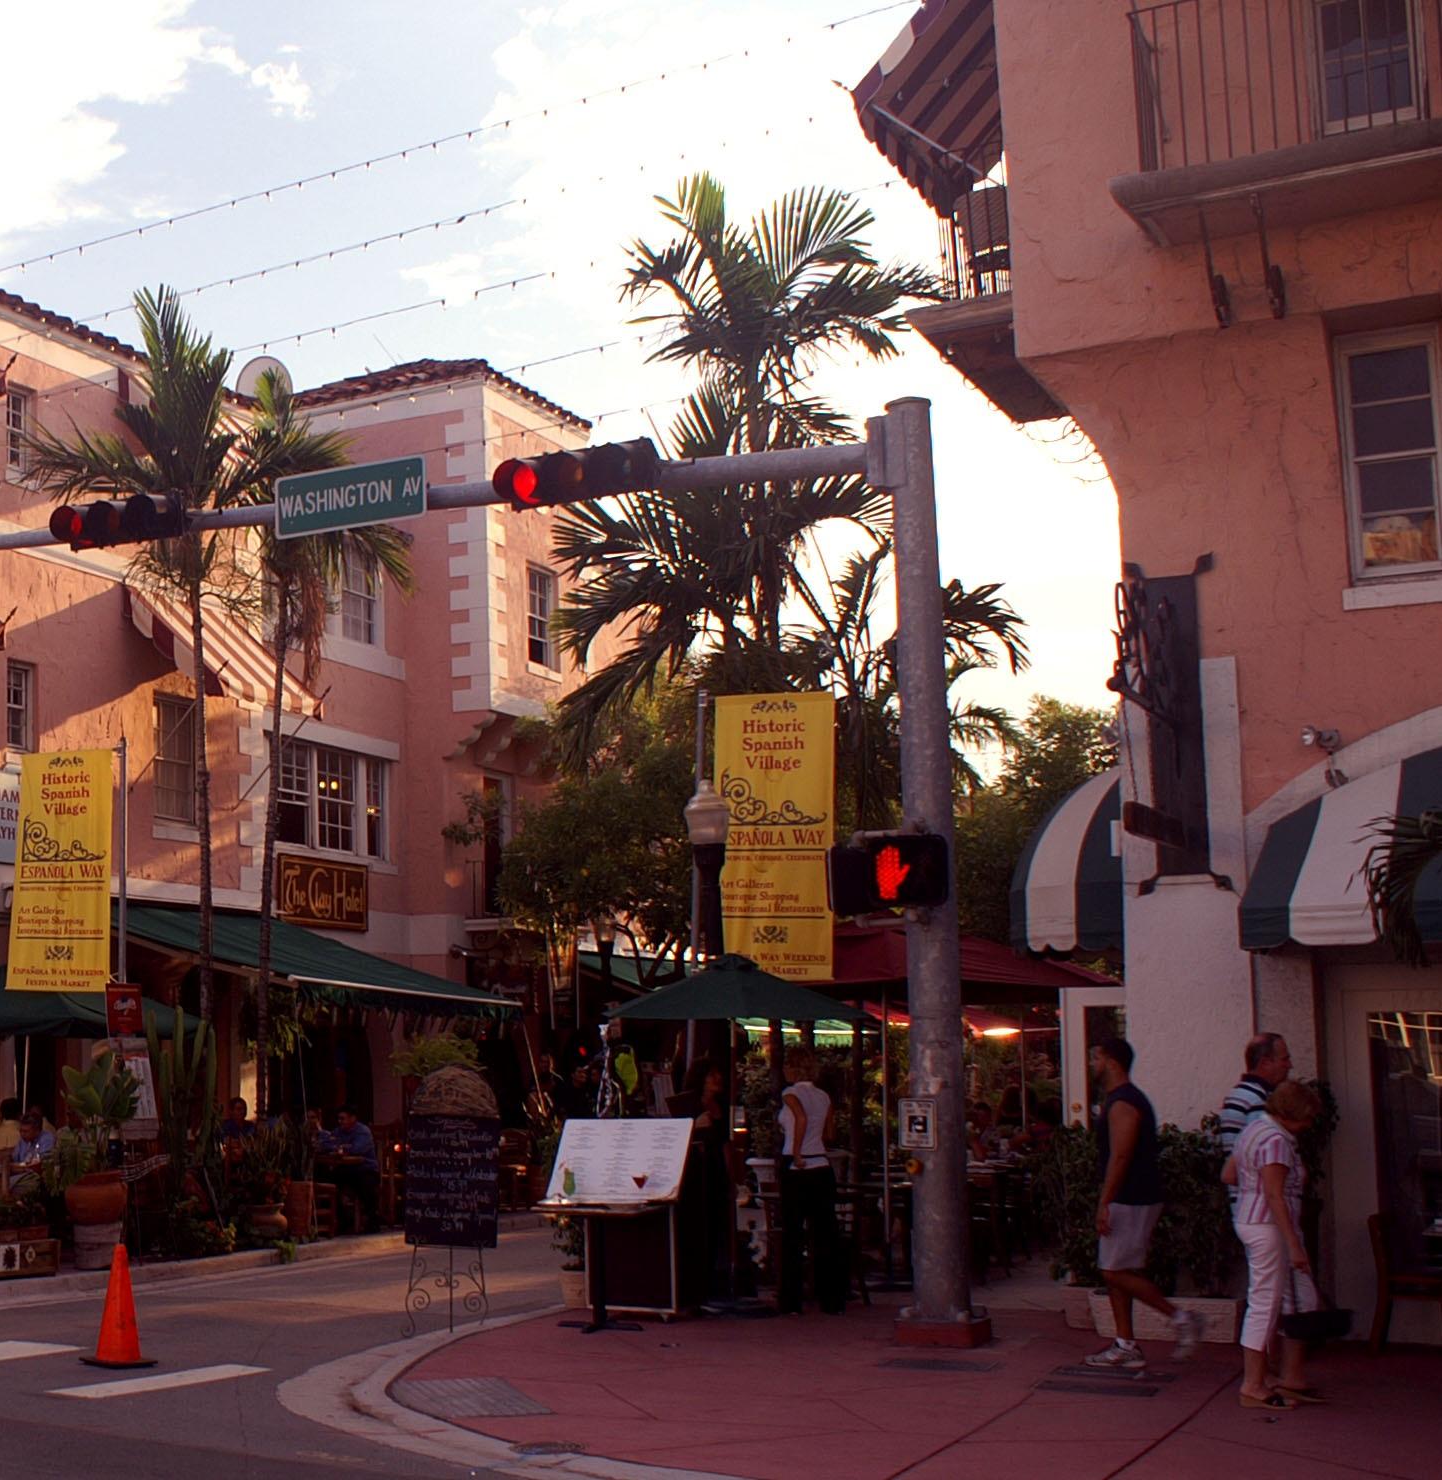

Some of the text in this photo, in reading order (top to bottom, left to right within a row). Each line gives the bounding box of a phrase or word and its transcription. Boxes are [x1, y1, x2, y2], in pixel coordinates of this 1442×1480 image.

[280, 476, 421, 519] WASHINGTON AV
[743, 719, 805, 733] Historic
[742, 737, 804, 752] Spanish
[746, 756, 801, 771] Village
[42, 771, 90, 785] Historic
[41, 786, 90, 801] Spanish
[44, 803, 87, 816] Village
[729, 828, 824, 846] SPAÑOLA WAY
[21, 863, 104, 878] ESPAÑOLA WAY
[736, 878, 774, 889] Galleries
[285, 864, 363, 920] The Clay Hotel
[722, 891, 799, 904] outique Shopping
[19, 905, 65, 915] Art Galleries
[724, 903, 823, 913] ternational Restaurants
[18, 916, 84, 927] Boutique Shopping
[17, 926, 62, 935] International
[760, 952, 779, 961] WAY
[782, 952, 826, 961] WEEKEND
[772, 967, 808, 976] MARKET
